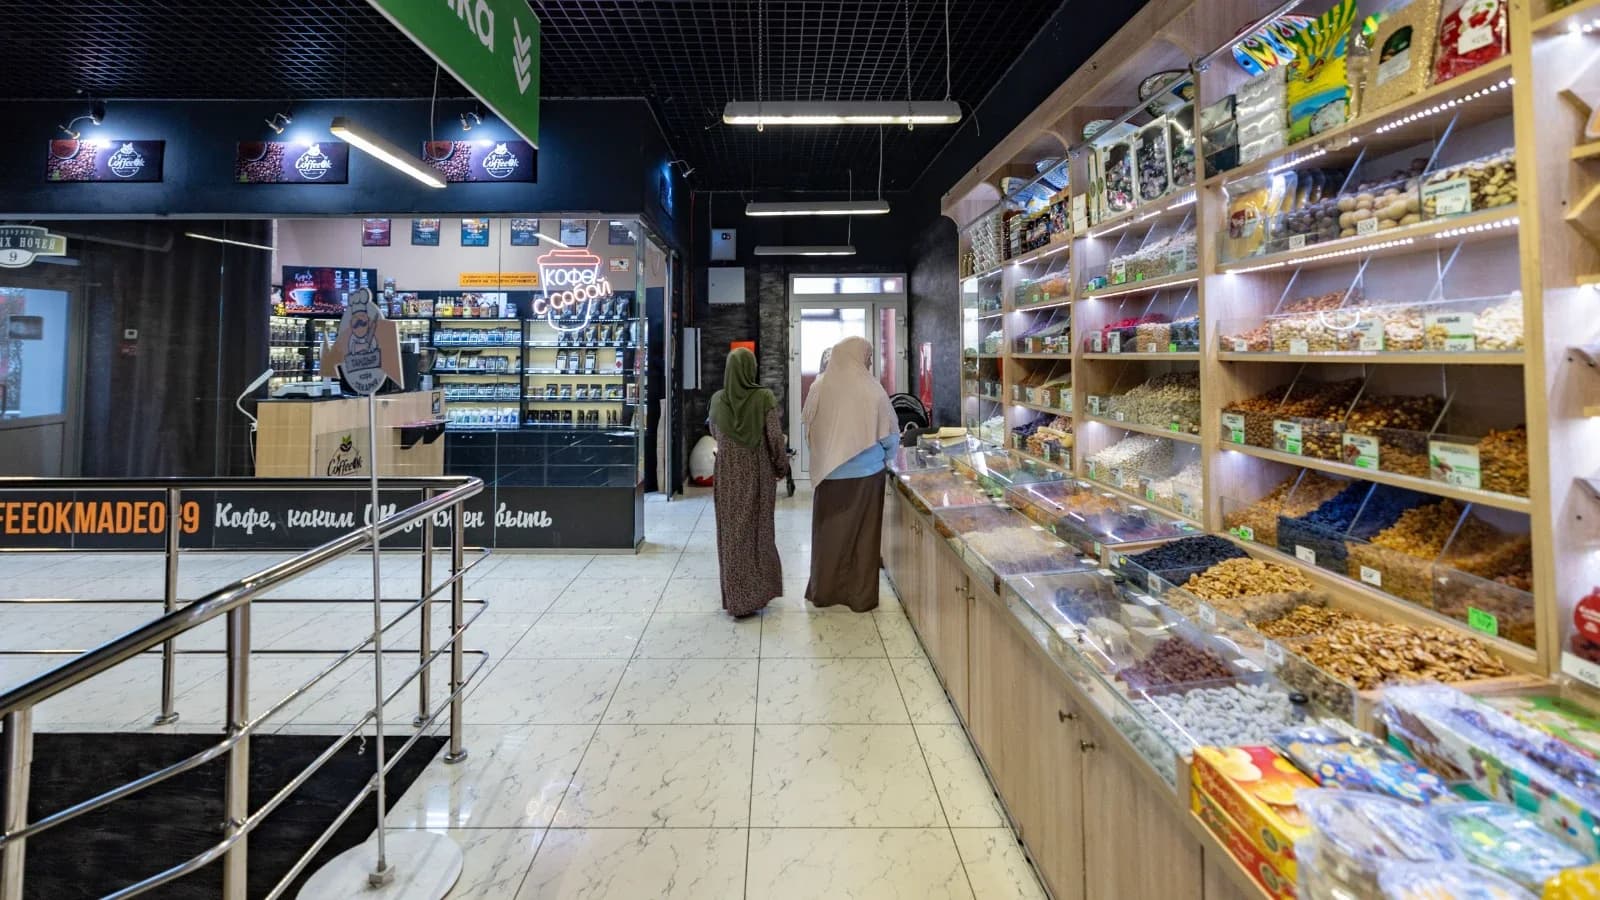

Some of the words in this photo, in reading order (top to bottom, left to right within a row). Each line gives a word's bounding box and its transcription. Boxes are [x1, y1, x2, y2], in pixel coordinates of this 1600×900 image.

[9, 251, 17, 261] 9
[215, 502, 276, 535] Кофе,
[287, 509, 355, 528] каким
[494, 502, 552, 528] быть
